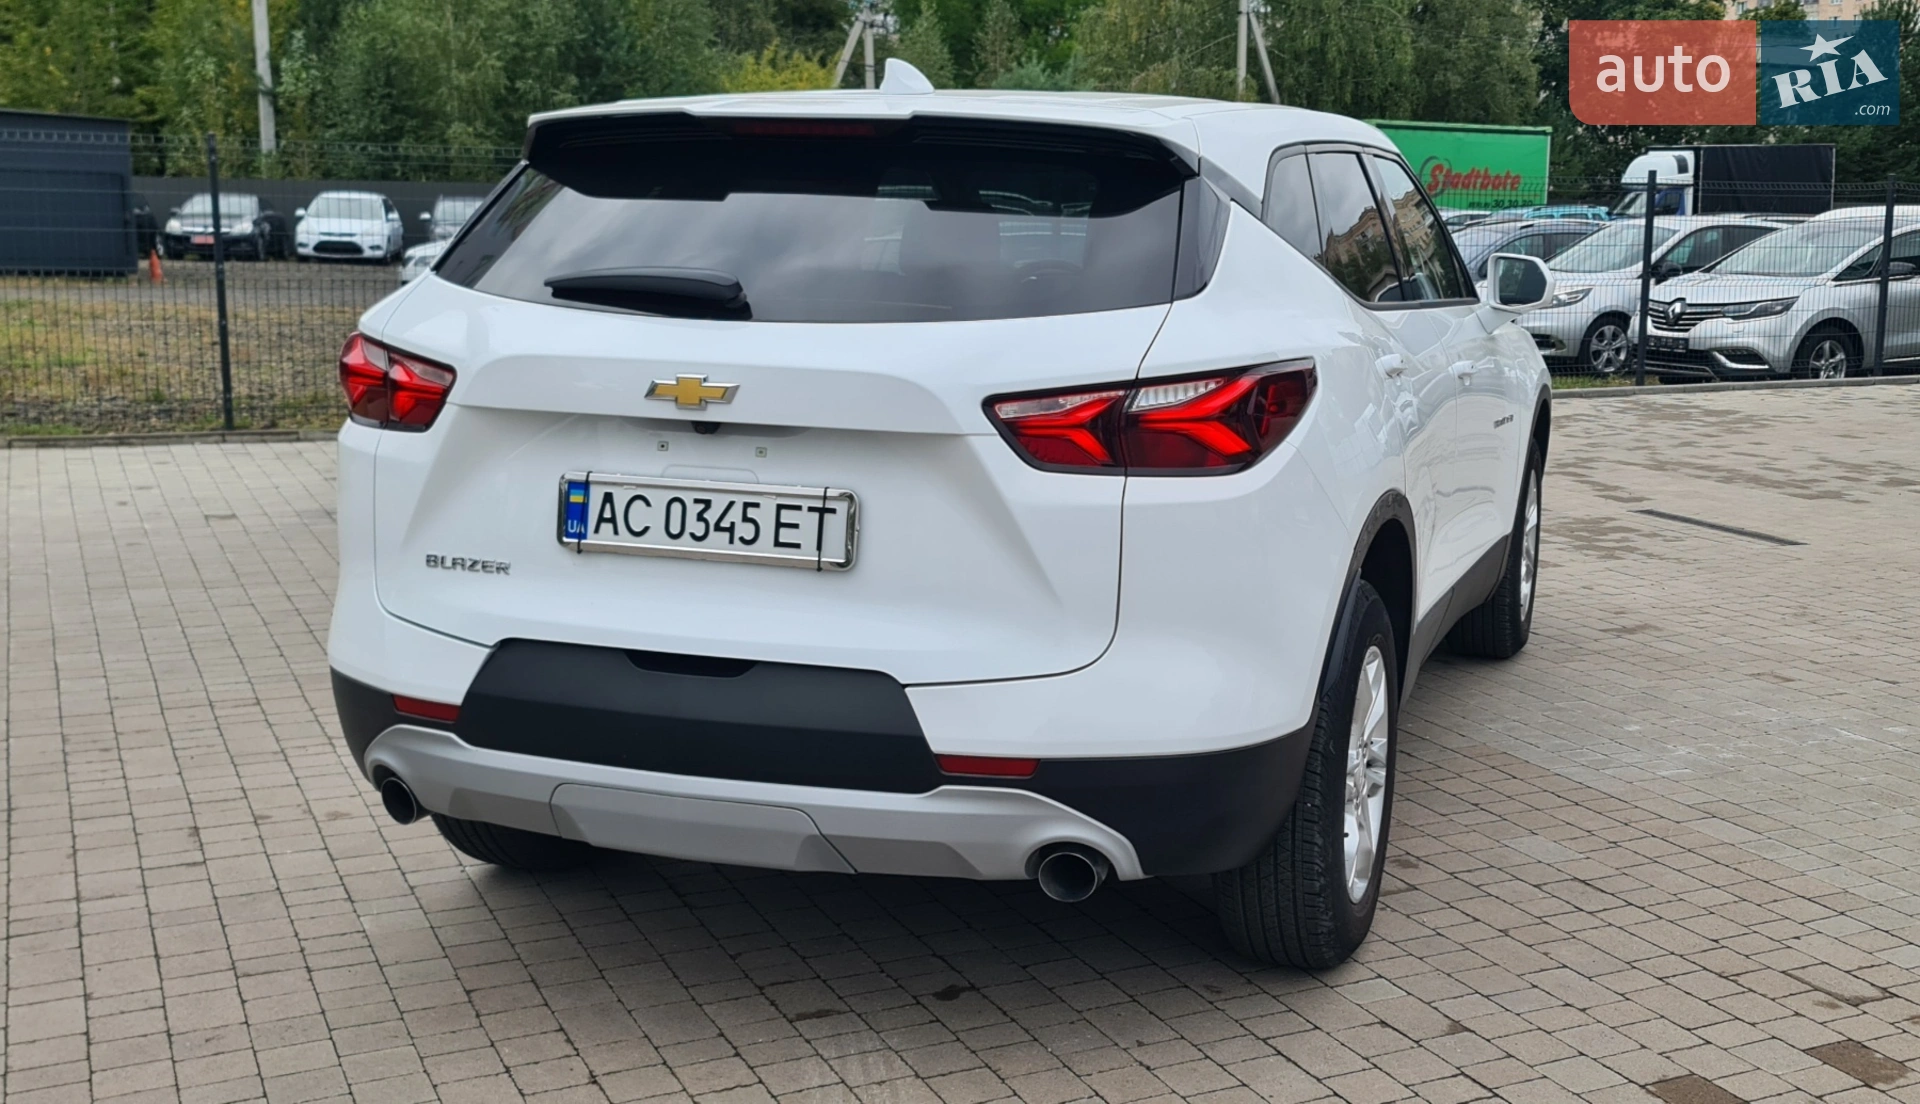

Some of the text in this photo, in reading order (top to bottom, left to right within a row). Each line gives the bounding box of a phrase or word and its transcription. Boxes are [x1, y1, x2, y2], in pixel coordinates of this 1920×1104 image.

[1427, 163, 1521, 192] Stadtbote
[594, 492, 837, 551] AC 0345 ET
[425, 554, 511, 575] BLAZER
